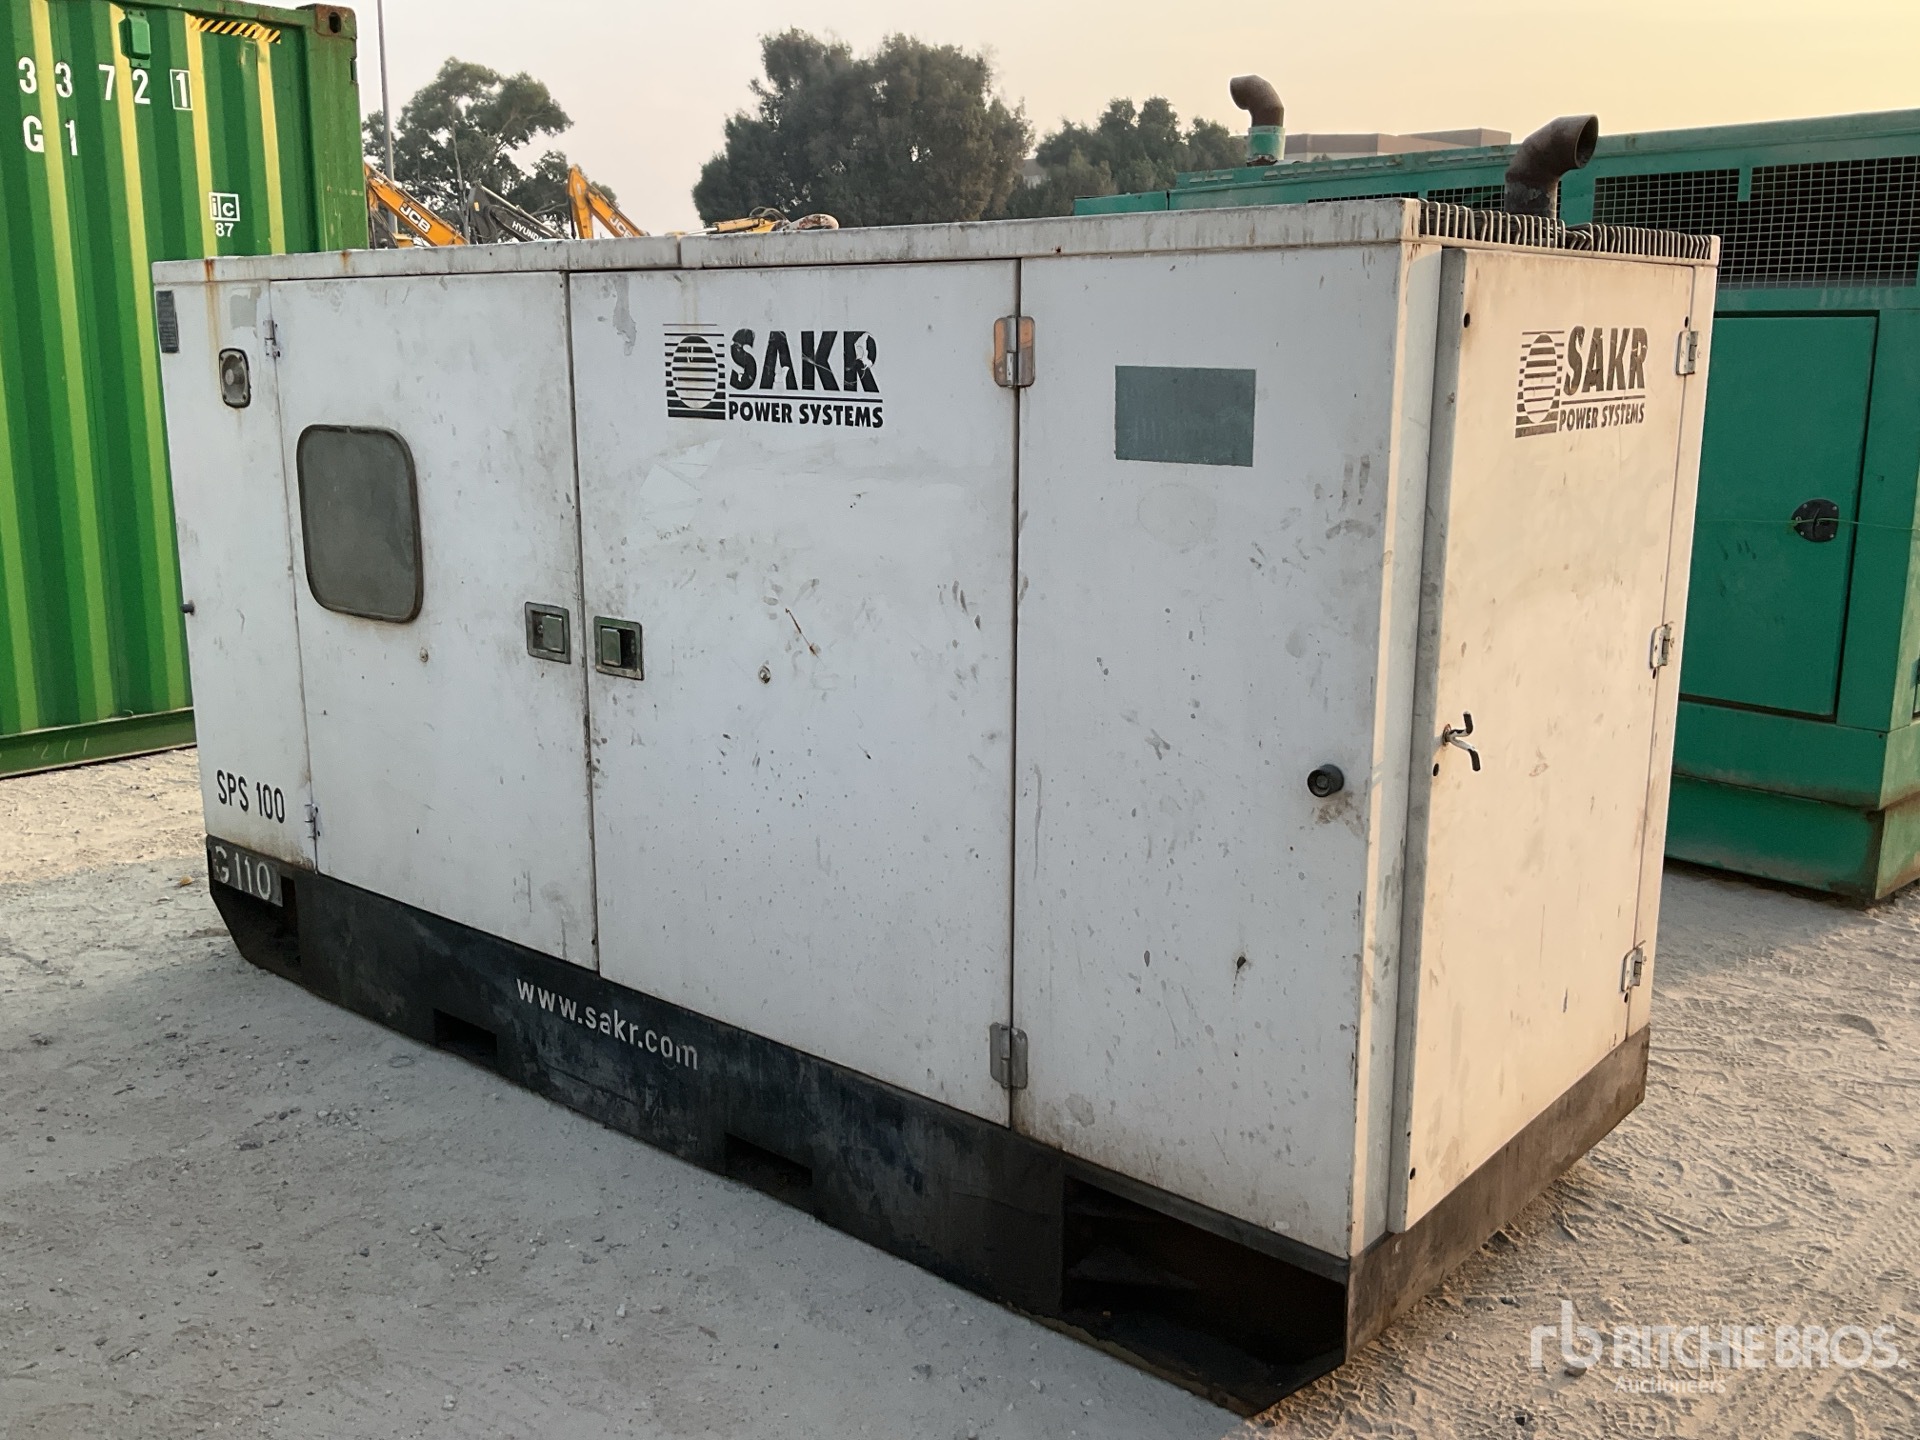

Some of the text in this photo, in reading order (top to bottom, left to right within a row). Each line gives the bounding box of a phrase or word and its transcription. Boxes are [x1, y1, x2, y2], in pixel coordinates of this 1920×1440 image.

[215, 223, 234, 238] 87
[400, 202, 432, 235] JCB
[511, 220, 544, 241] HYUNDA
[729, 328, 880, 393] SAKR
[1563, 325, 1648, 396] SAKR
[729, 401, 884, 429] POWER SYSTEMS
[1558, 402, 1645, 432] POWER SYSTEMS
[217, 769, 286, 824] SPS 100
[516, 978, 699, 1071] www.sakr.com
